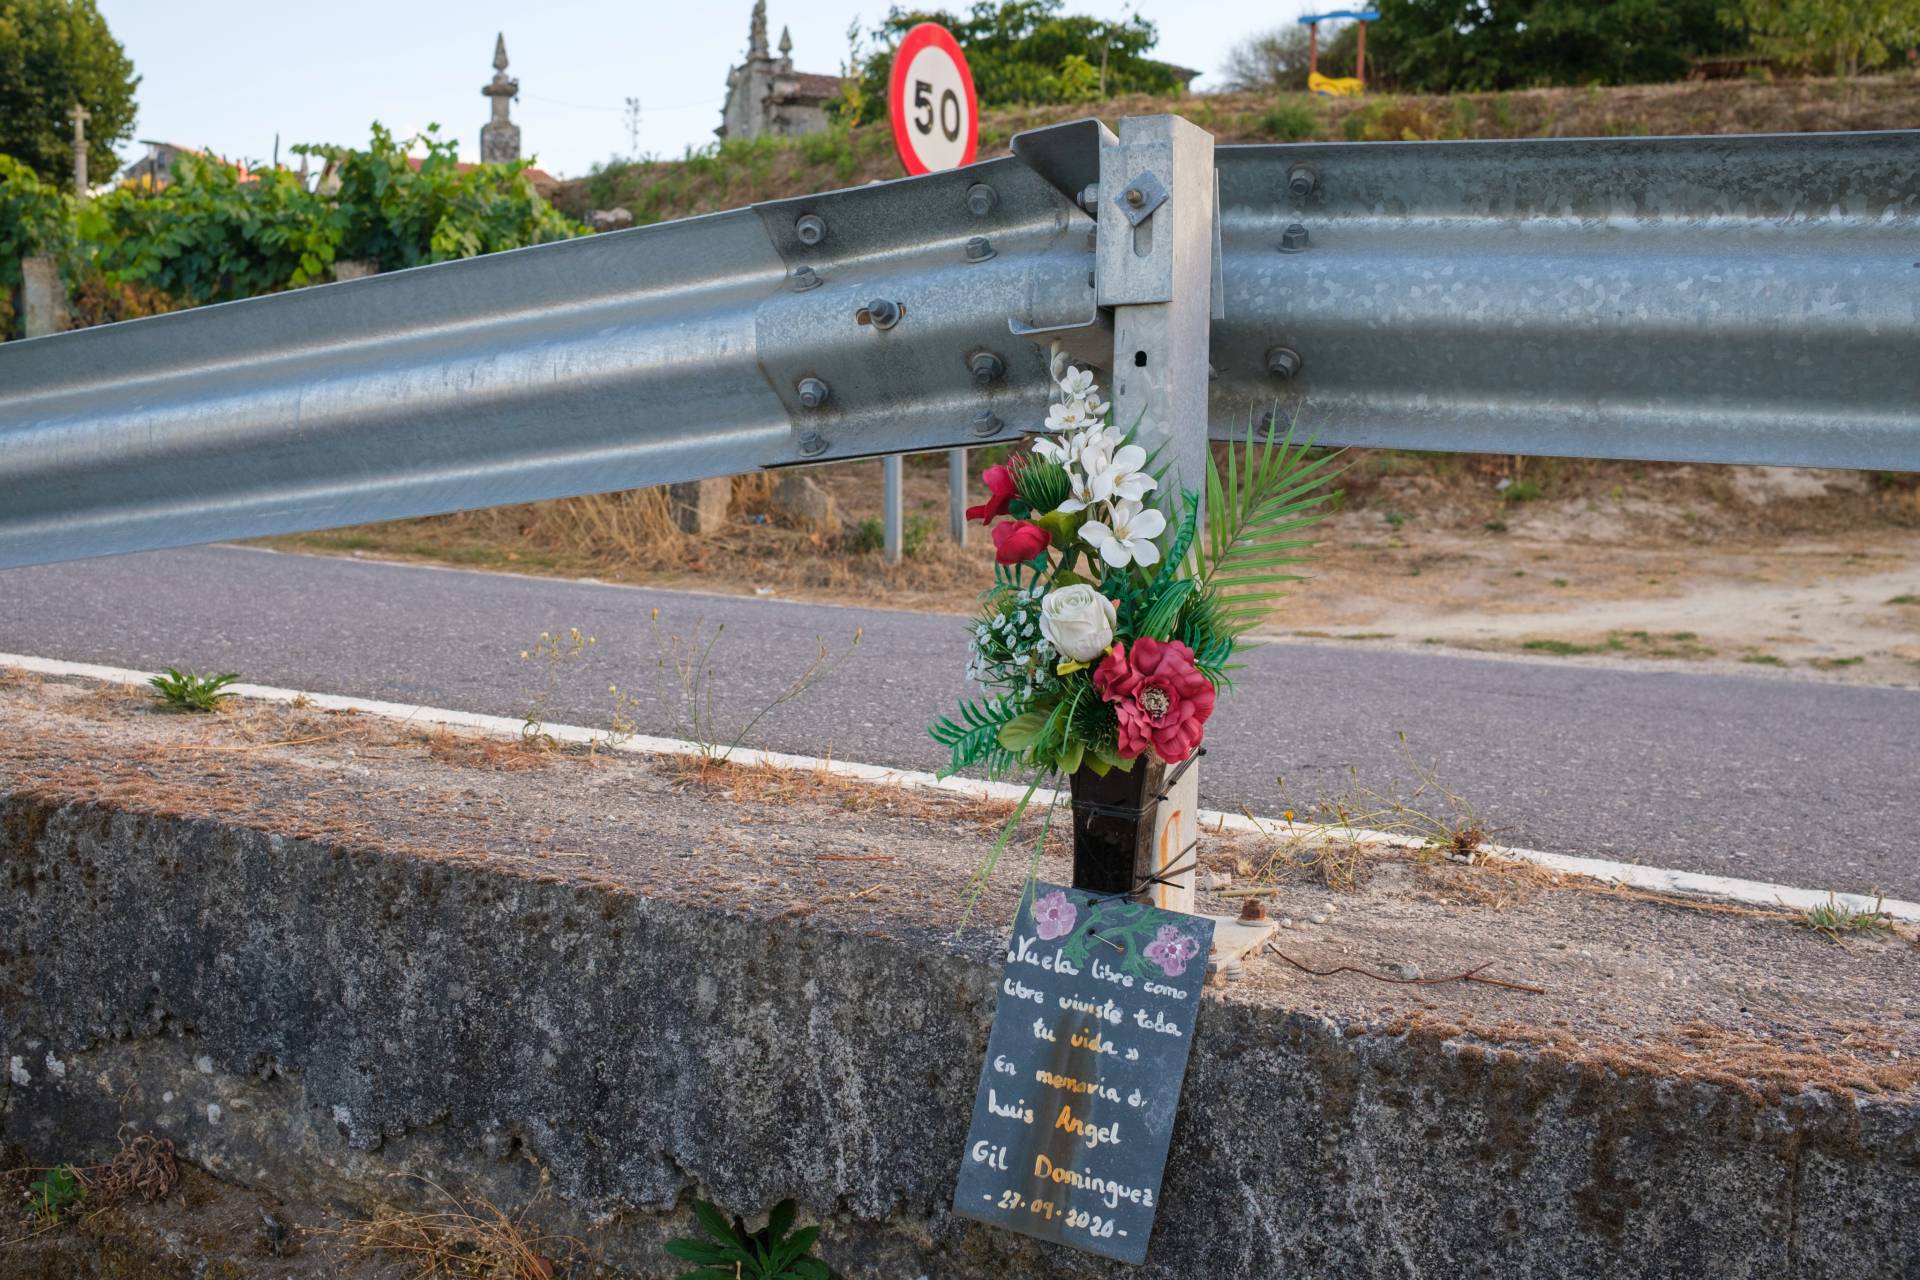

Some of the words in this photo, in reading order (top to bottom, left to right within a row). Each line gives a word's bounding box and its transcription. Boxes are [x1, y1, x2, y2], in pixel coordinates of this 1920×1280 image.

[914, 79, 960, 143] 50
[1004, 978, 1044, 1003] libre
[1059, 994, 1122, 1024] viviste
[1134, 1009, 1182, 1036] toda
[1092, 959, 1133, 987] libre
[1144, 982, 1187, 1000] como
[1033, 1018, 1056, 1041] tu
[1071, 1028, 1118, 1053] vida
[994, 1055, 1016, 1075] En
[1035, 1070, 1121, 1103] memoria
[988, 1089, 1034, 1124] Luis
[1055, 1104, 1121, 1148] Angel
[972, 1140, 1008, 1170] Gil
[1034, 1154, 1154, 1208] Dominguez
